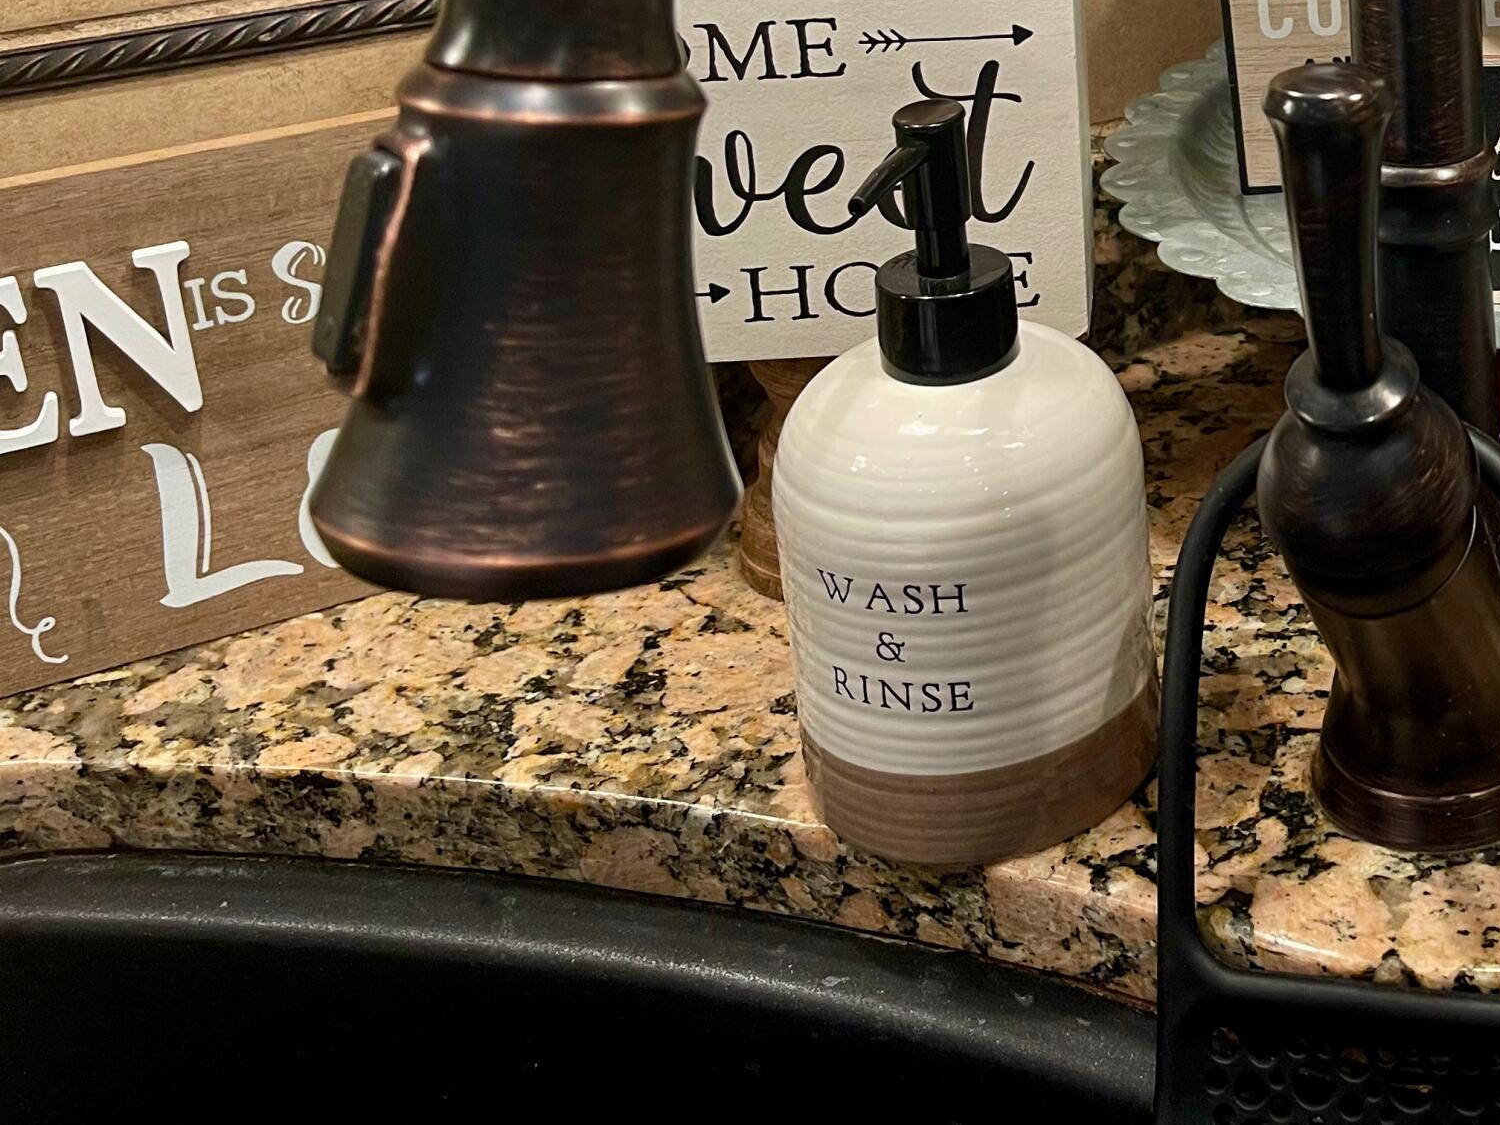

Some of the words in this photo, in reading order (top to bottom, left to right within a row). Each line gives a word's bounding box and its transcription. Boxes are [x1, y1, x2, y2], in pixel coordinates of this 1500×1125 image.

[184, 269, 257, 332] IS
[816, 567, 969, 616] WASH
[875, 631, 906, 663] &
[832, 665, 975, 713] RINSE
